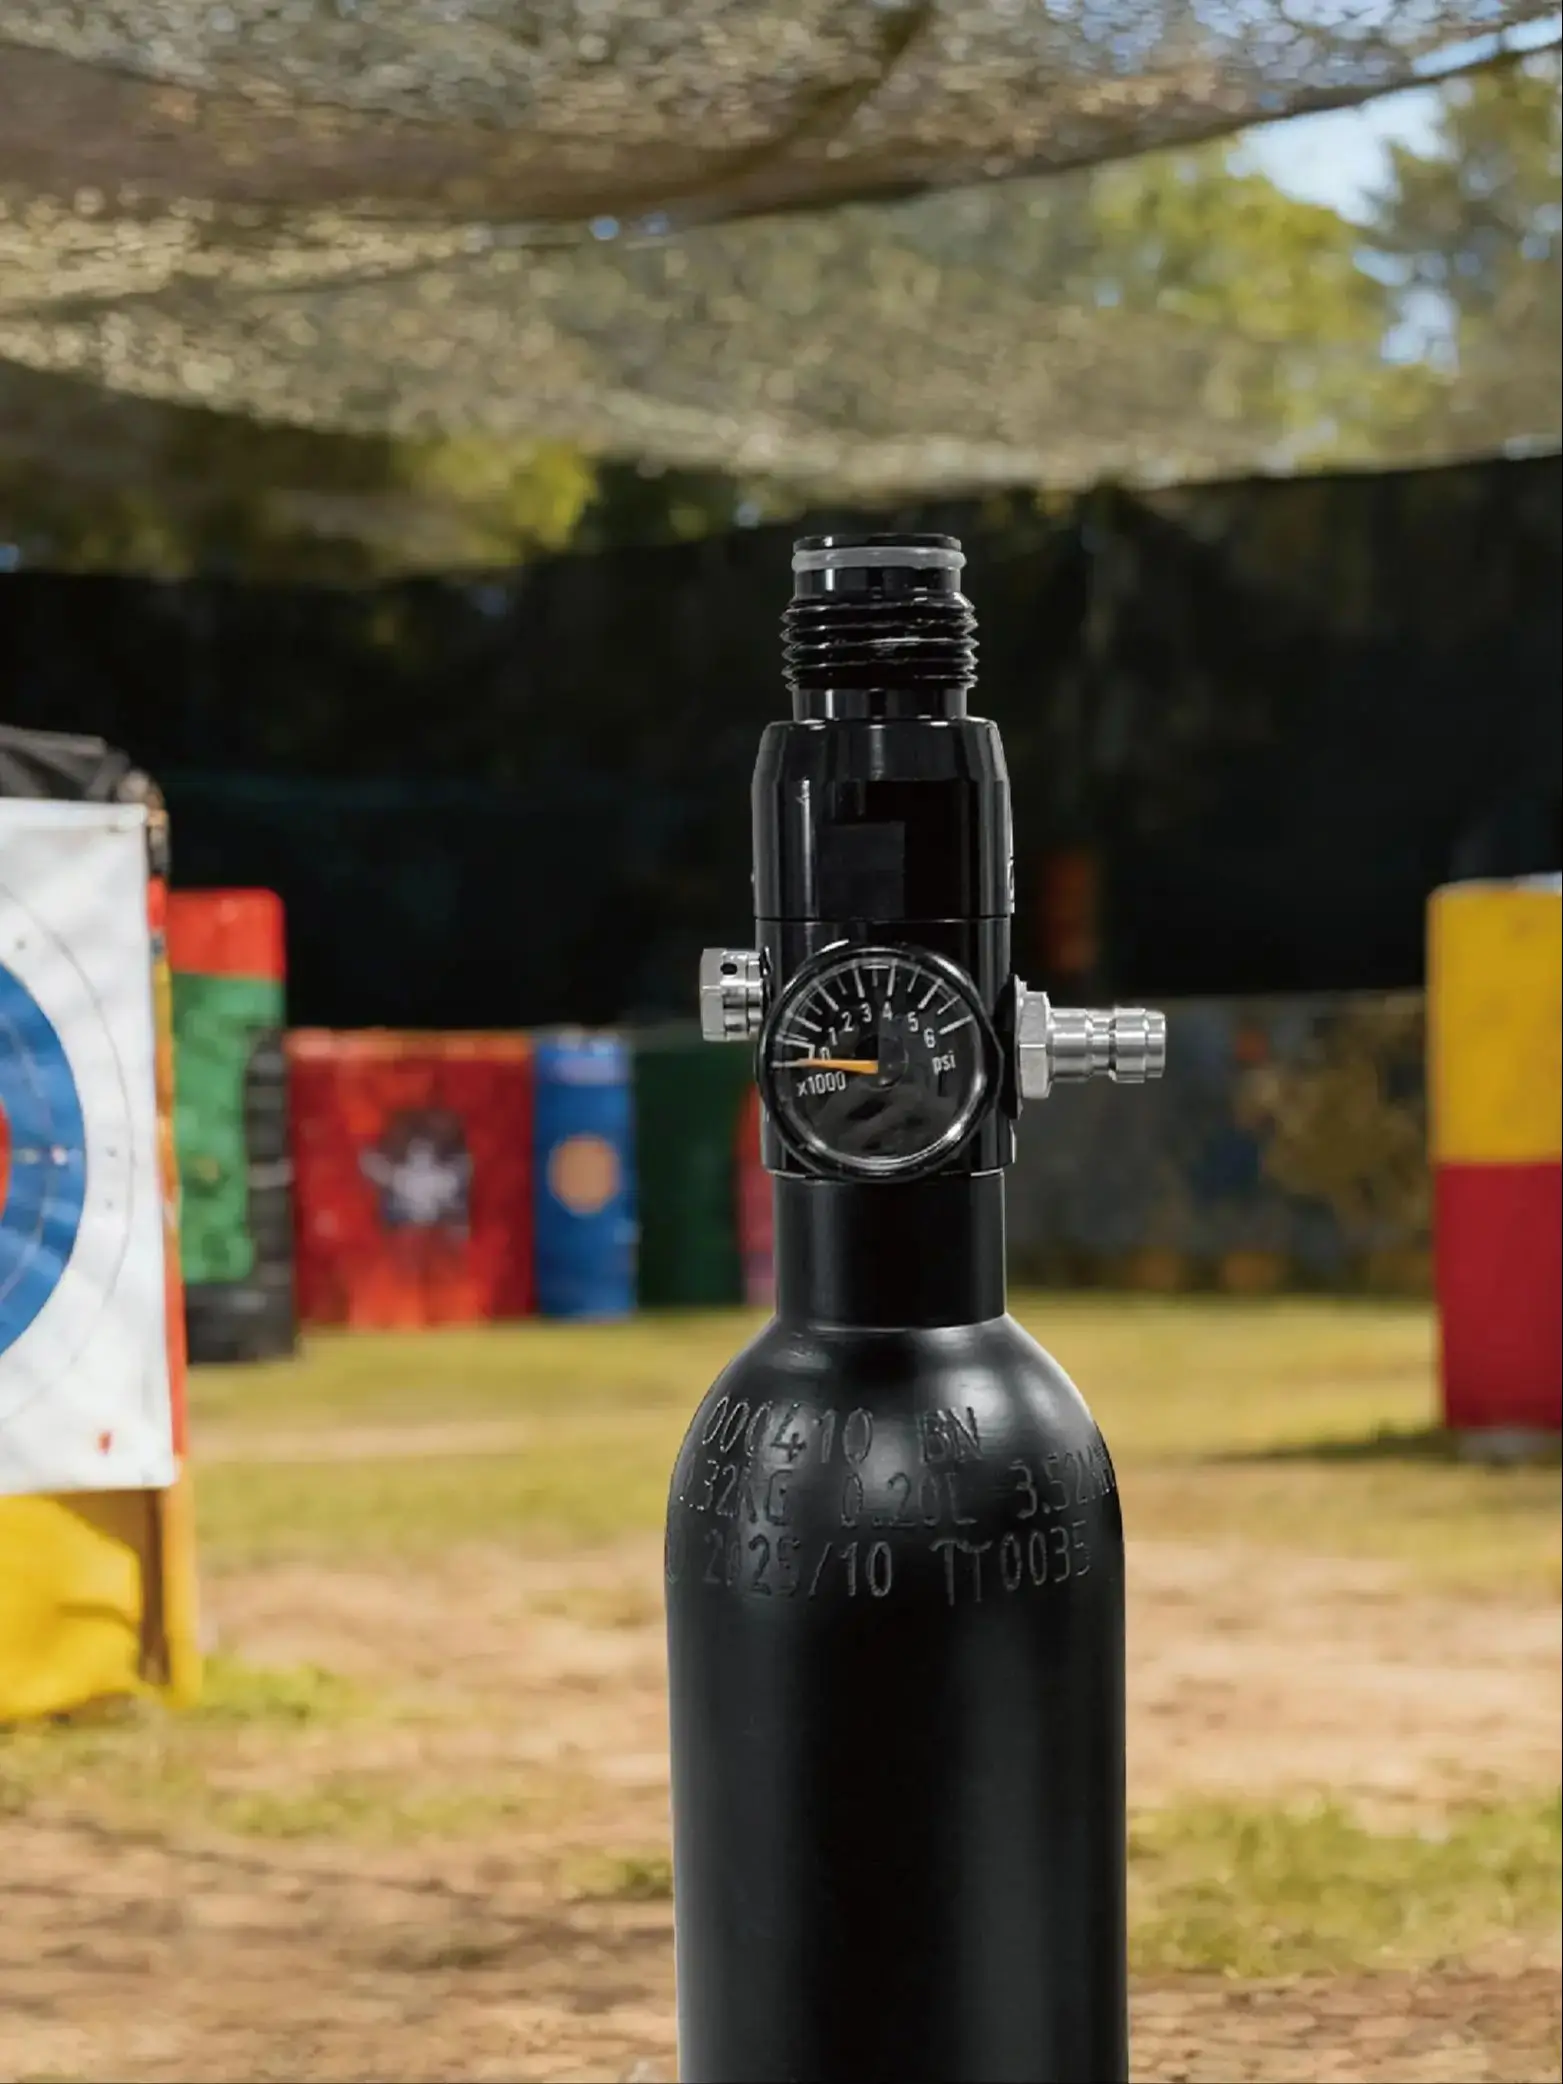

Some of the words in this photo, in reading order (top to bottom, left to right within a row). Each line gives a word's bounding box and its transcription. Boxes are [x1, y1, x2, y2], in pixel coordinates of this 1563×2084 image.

[828, 1027, 838, 1046] 1
[841, 1011, 853, 1032] 2
[860, 1002, 872, 1022] 3
[882, 1001, 893, 1020] 4
[907, 1011, 919, 1032] 5
[923, 1028, 936, 1048] 6
[931, 1050, 957, 1076] psi
